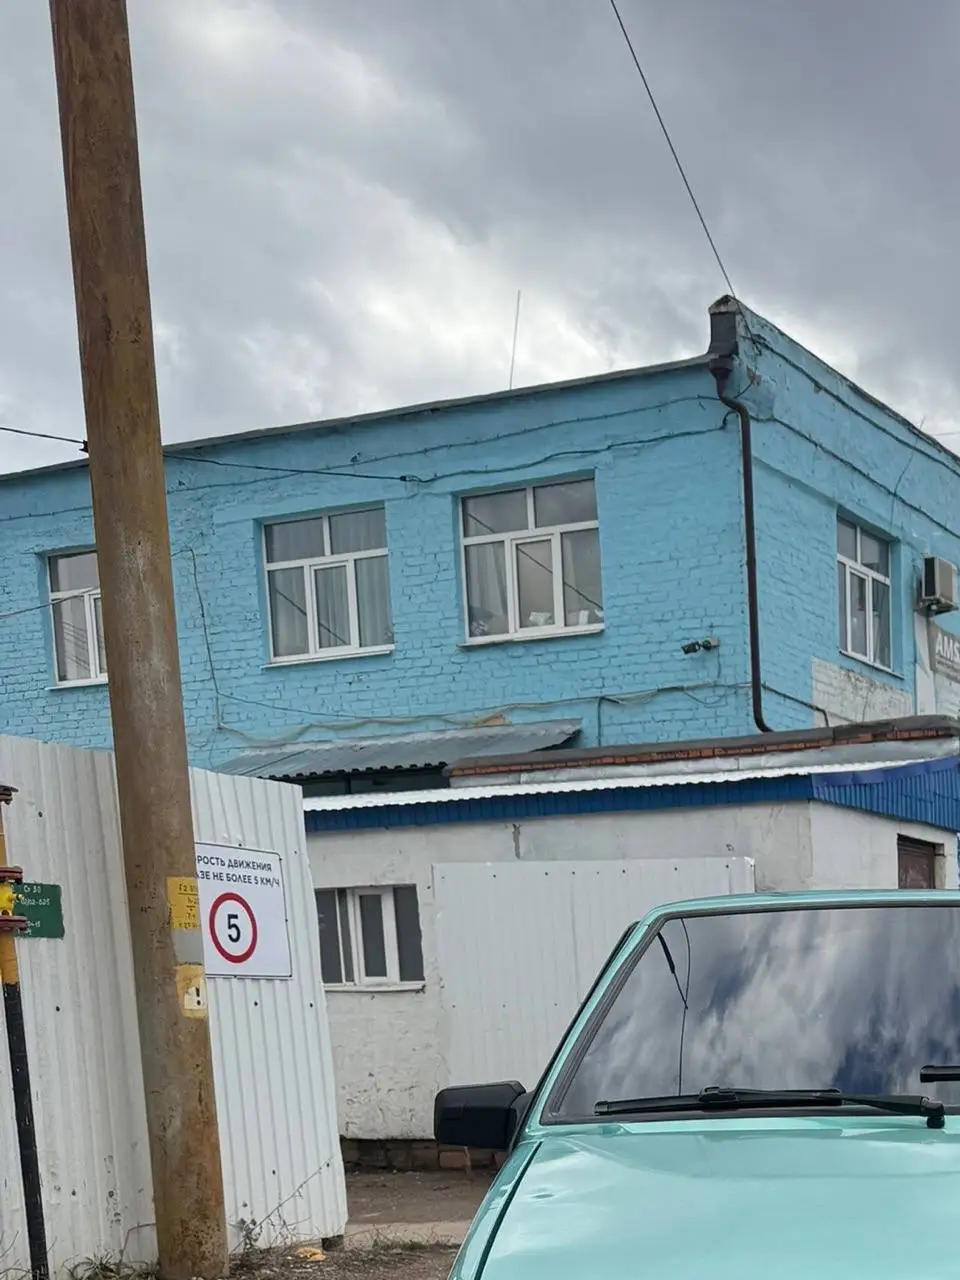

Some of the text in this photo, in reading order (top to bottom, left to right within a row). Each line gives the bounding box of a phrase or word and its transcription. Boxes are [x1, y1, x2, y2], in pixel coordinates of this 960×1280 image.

[195, 855, 272, 872] РОСТЬ ДВИЖЕНИЯ
[212, 871, 224, 881] НЕ
[225, 873, 252, 885] БОЛЕЕ
[253, 875, 259, 885] 5
[260, 876, 280, 888] КМ/Ч
[227, 913, 241, 943] 5
